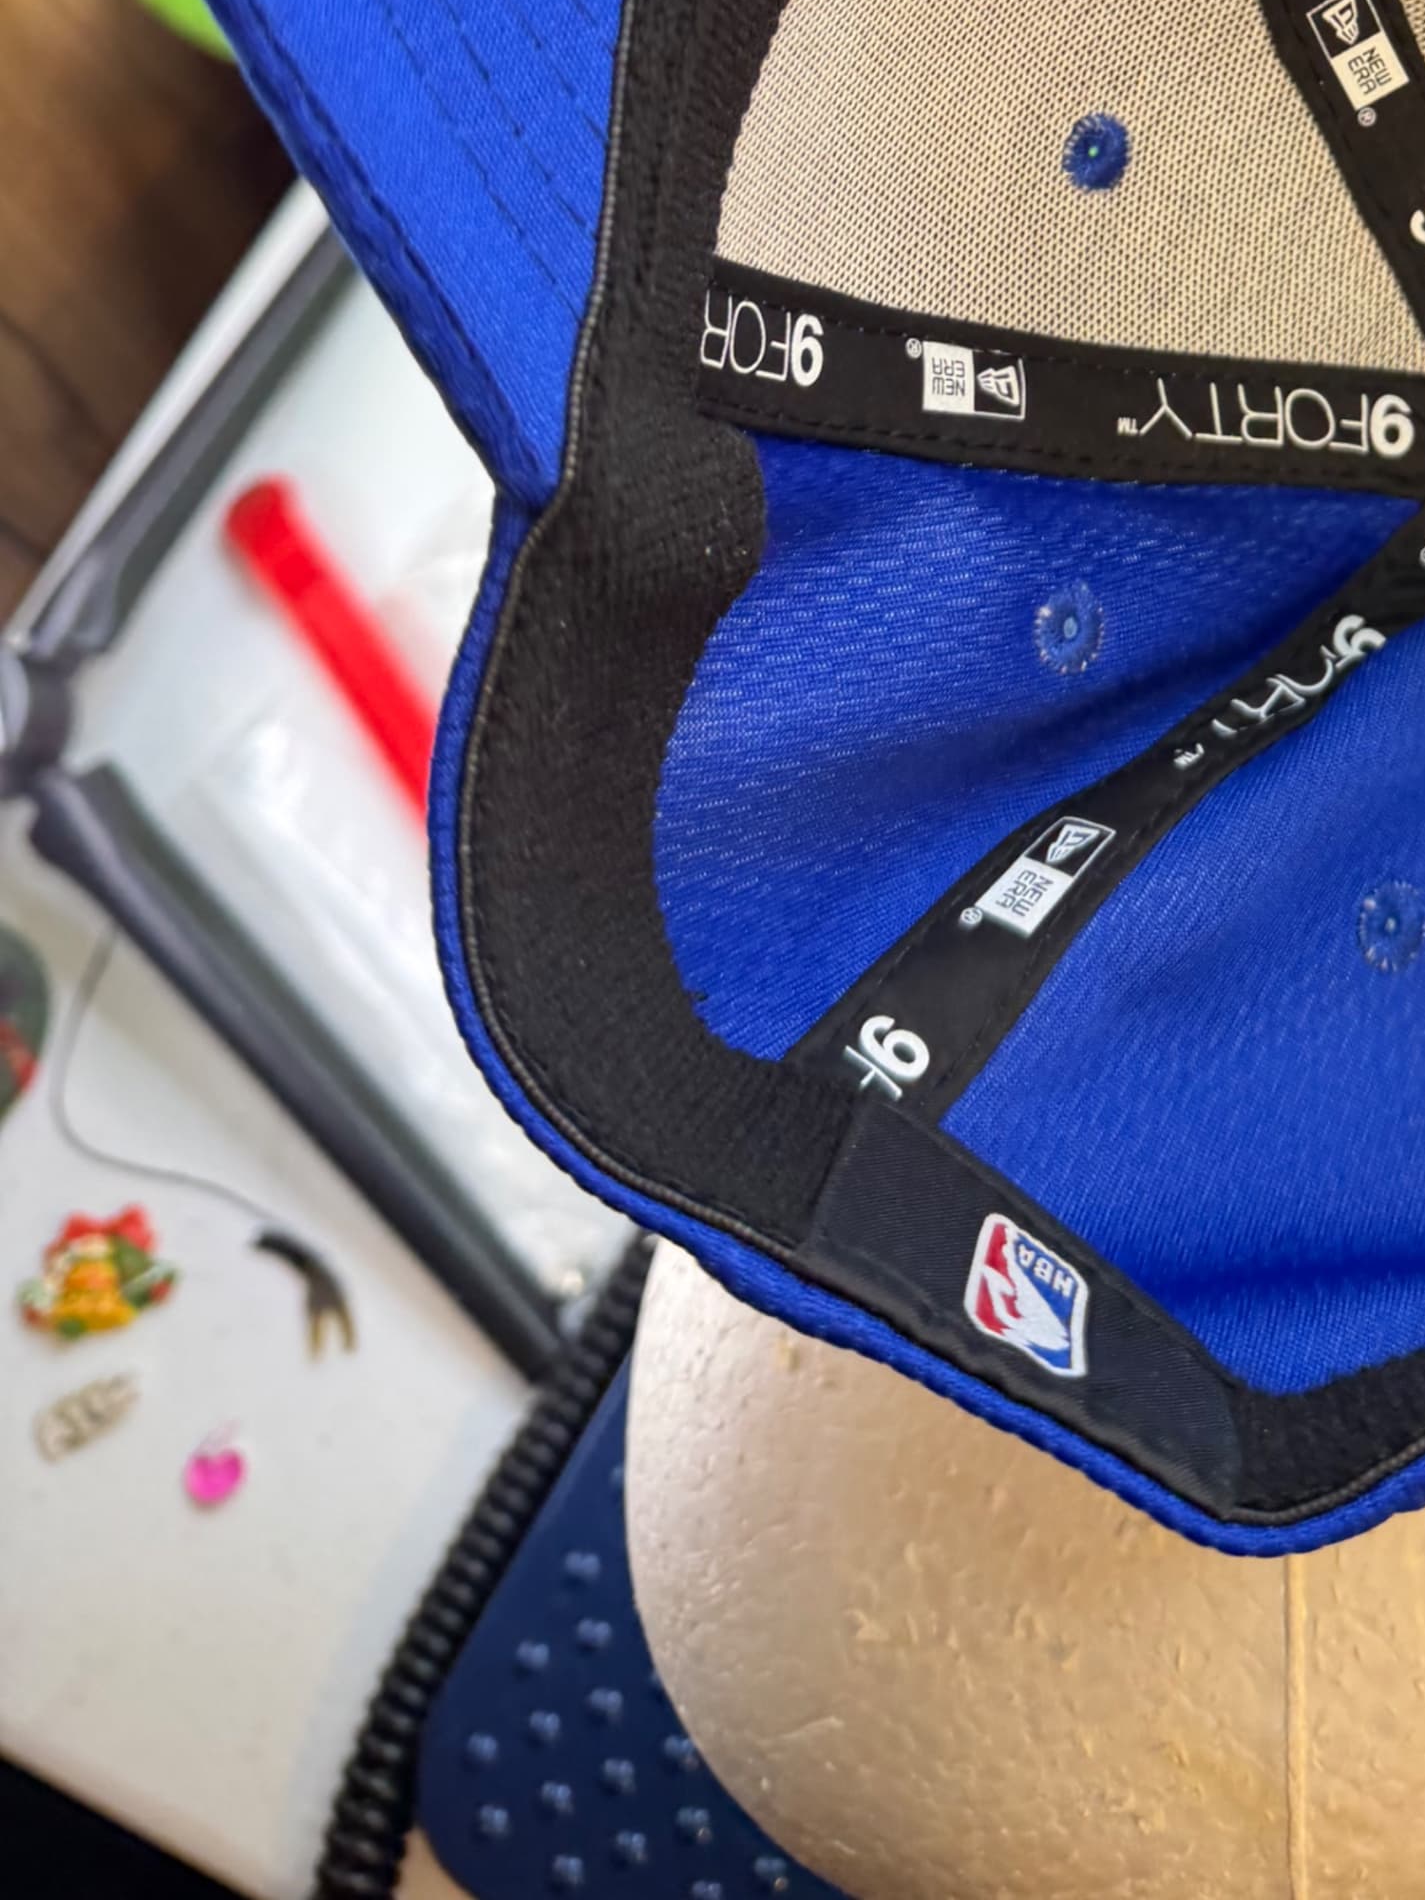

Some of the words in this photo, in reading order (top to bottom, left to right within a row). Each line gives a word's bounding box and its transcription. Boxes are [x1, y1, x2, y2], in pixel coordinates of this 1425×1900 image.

[1347, 54, 1378, 96] ERA
[1362, 46, 1393, 87] NEW
[931, 357, 966, 378] ERA
[931, 376, 966, 397] NEW
[995, 869, 1038, 909] ERA
[1011, 874, 1055, 917] NEW
[1018, 1243, 1075, 1298] NBA
